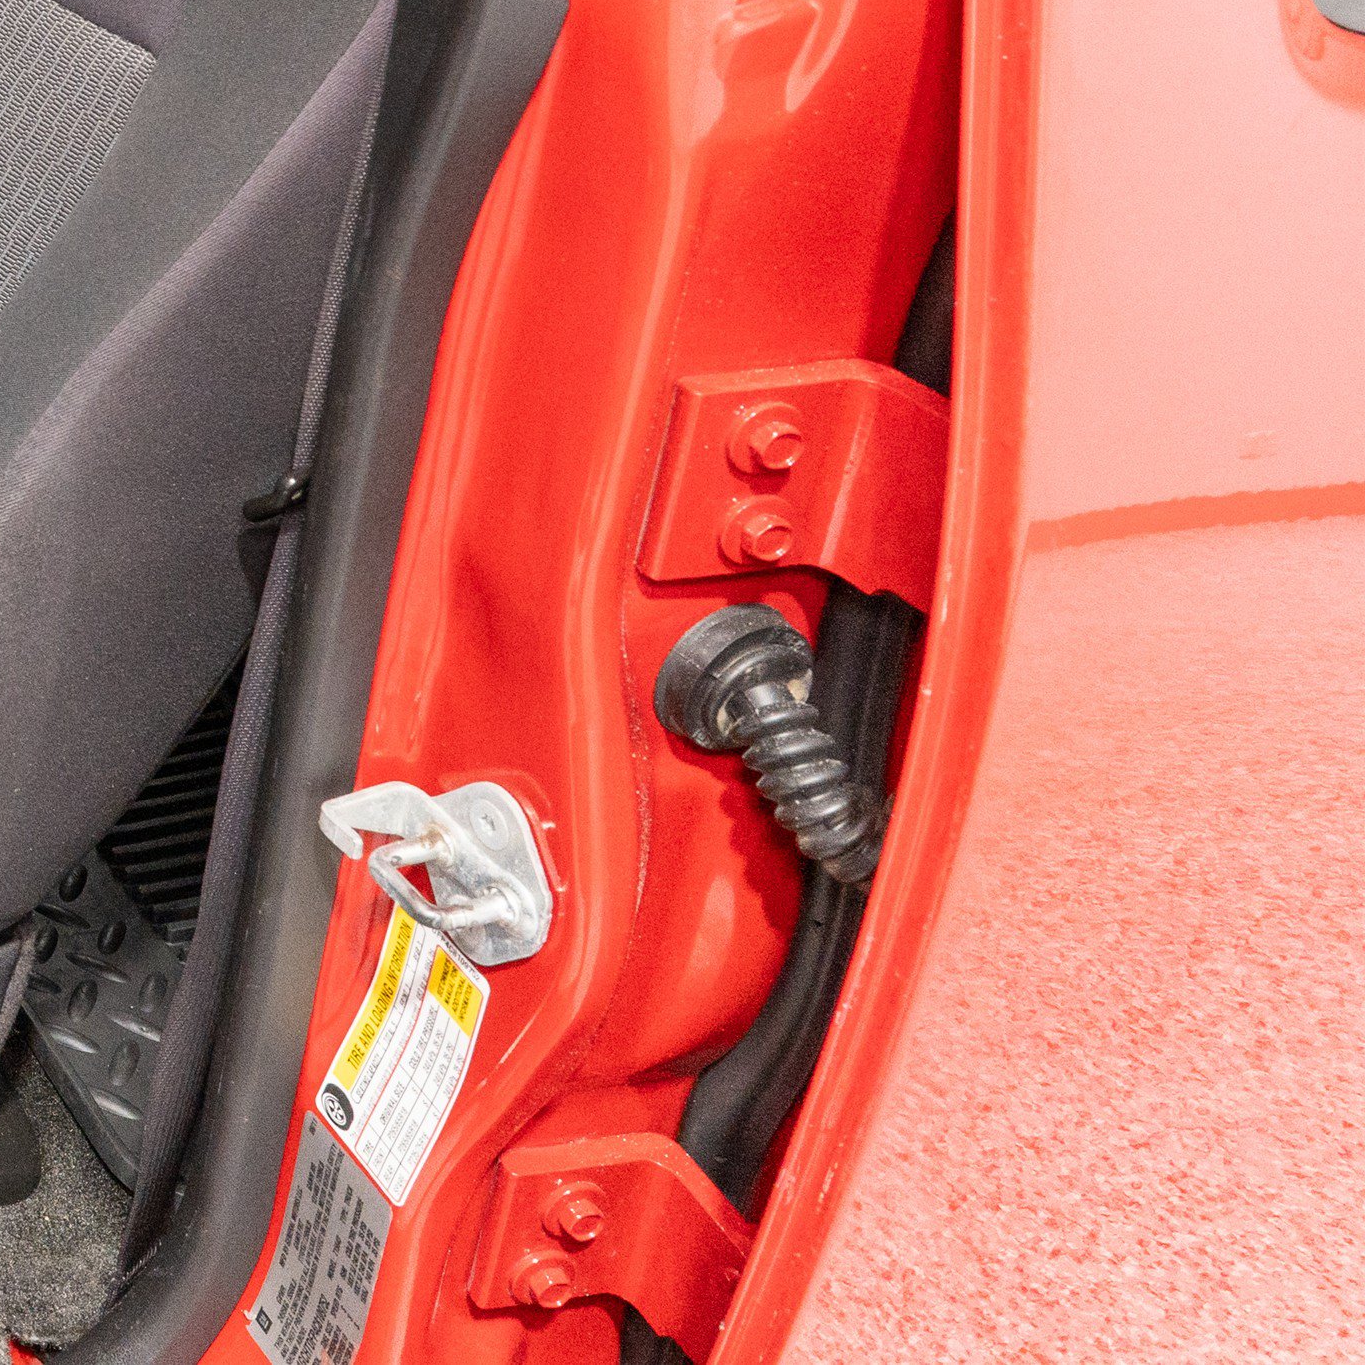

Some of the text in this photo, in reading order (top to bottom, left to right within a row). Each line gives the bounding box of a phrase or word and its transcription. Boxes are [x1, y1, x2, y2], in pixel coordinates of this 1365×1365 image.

[347, 1042, 364, 1071] TIRE
[358, 1020, 375, 1049] AND
[369, 980, 393, 1028] LOADING
[385, 918, 412, 987] INFORMATION
